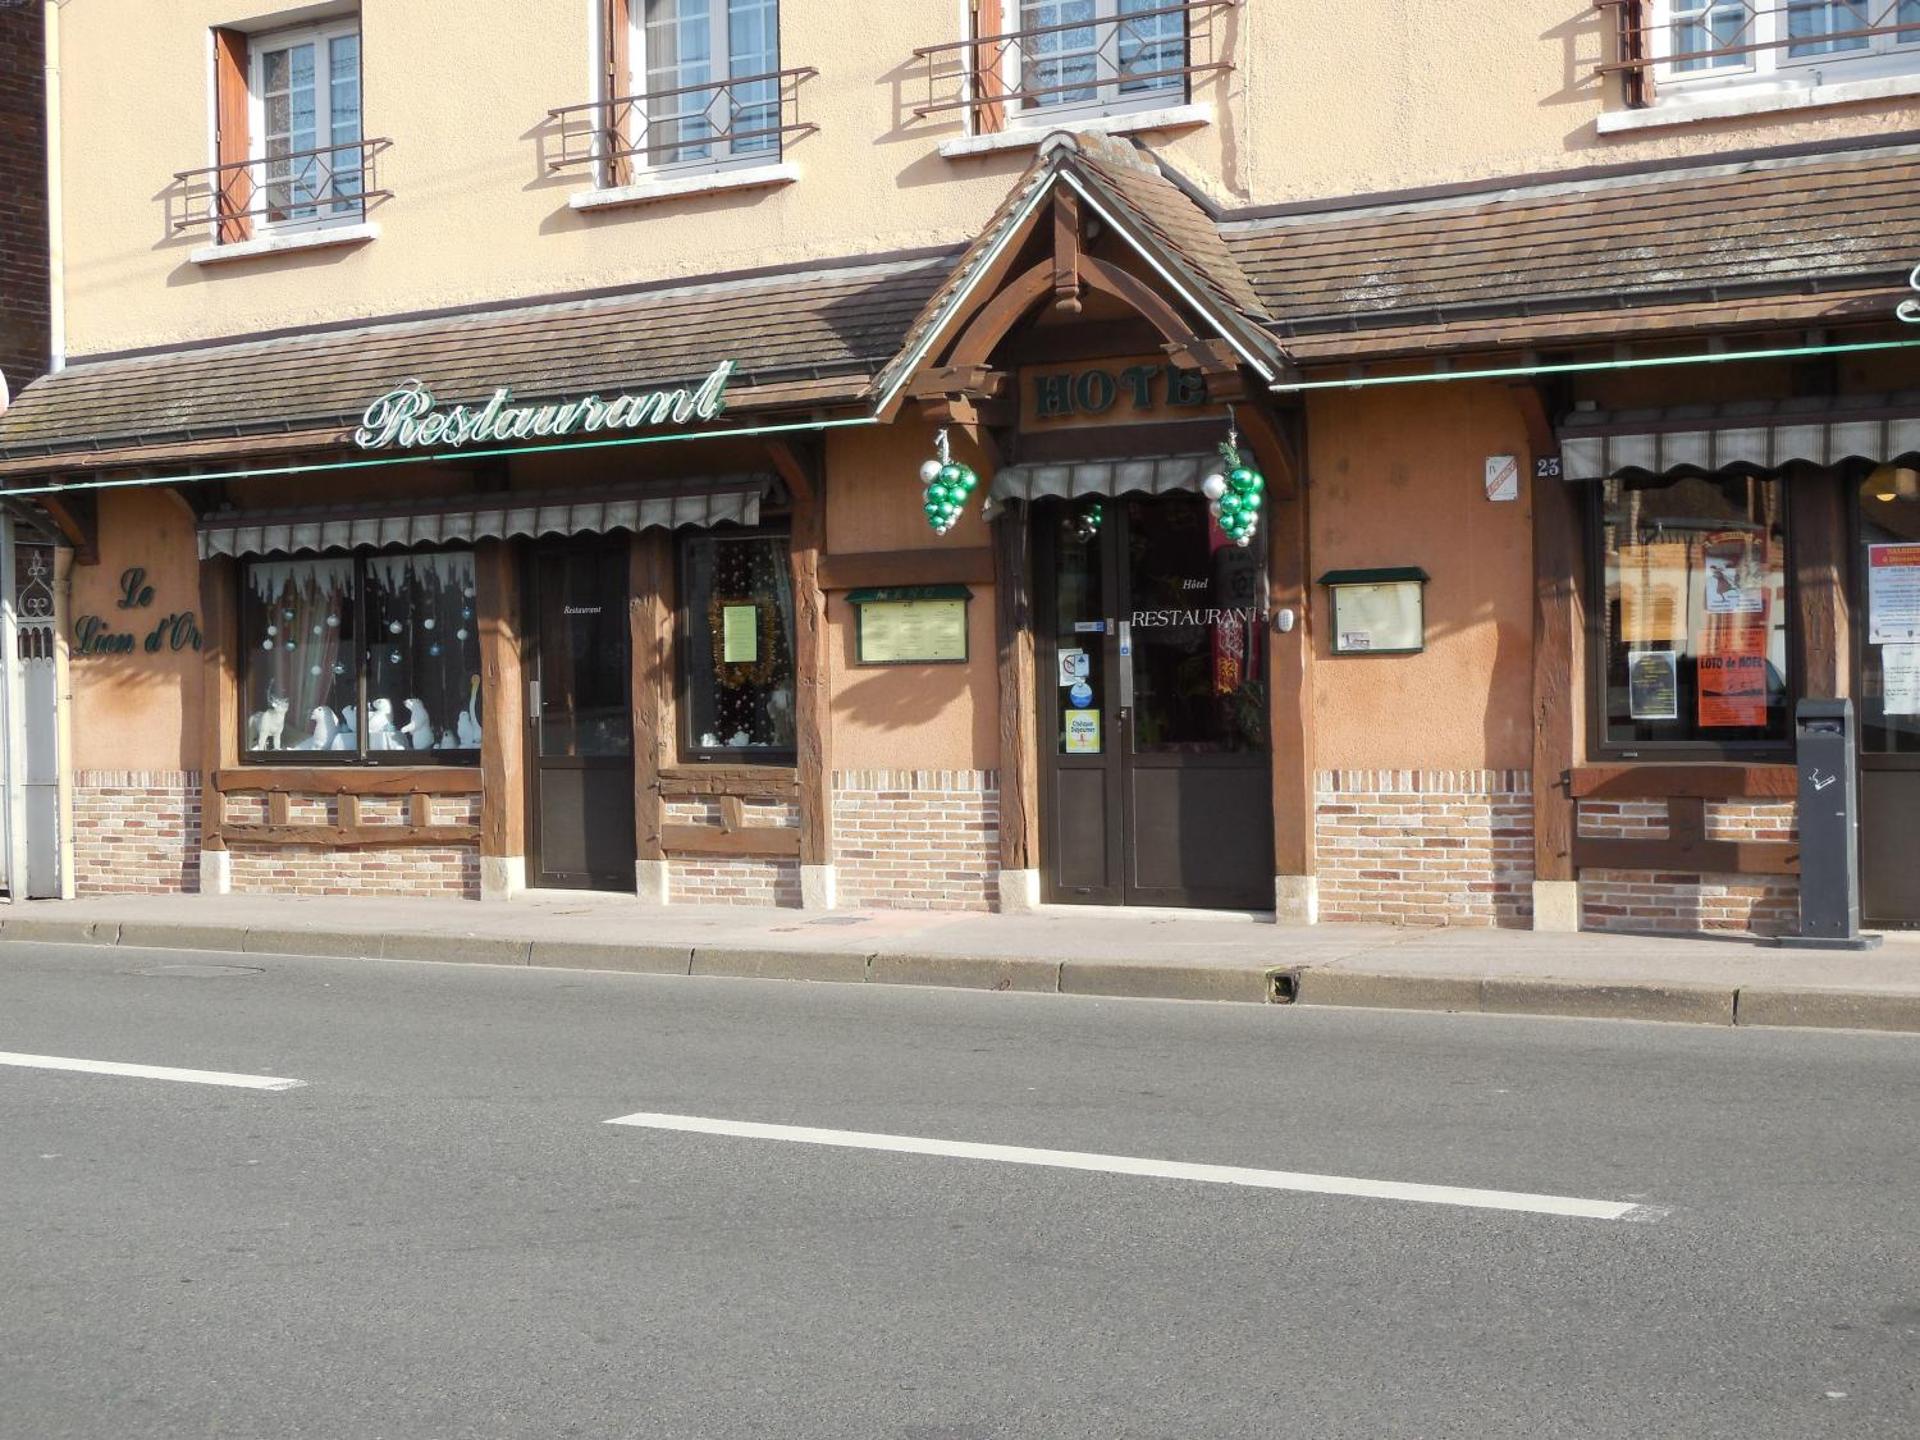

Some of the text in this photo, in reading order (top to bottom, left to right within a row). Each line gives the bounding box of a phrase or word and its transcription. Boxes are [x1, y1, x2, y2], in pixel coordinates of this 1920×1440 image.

[355, 360, 737, 449] Restaurant
[1035, 364, 1208, 416] HOTE
[1537, 458, 1559, 477] 23
[117, 567, 154, 609] Le
[1183, 578, 1208, 589] Hôtel
[1131, 606, 1257, 627] RESTAURANT
[73, 611, 202, 655] Lion d'Or
[1700, 657, 1723, 669] LOTO
